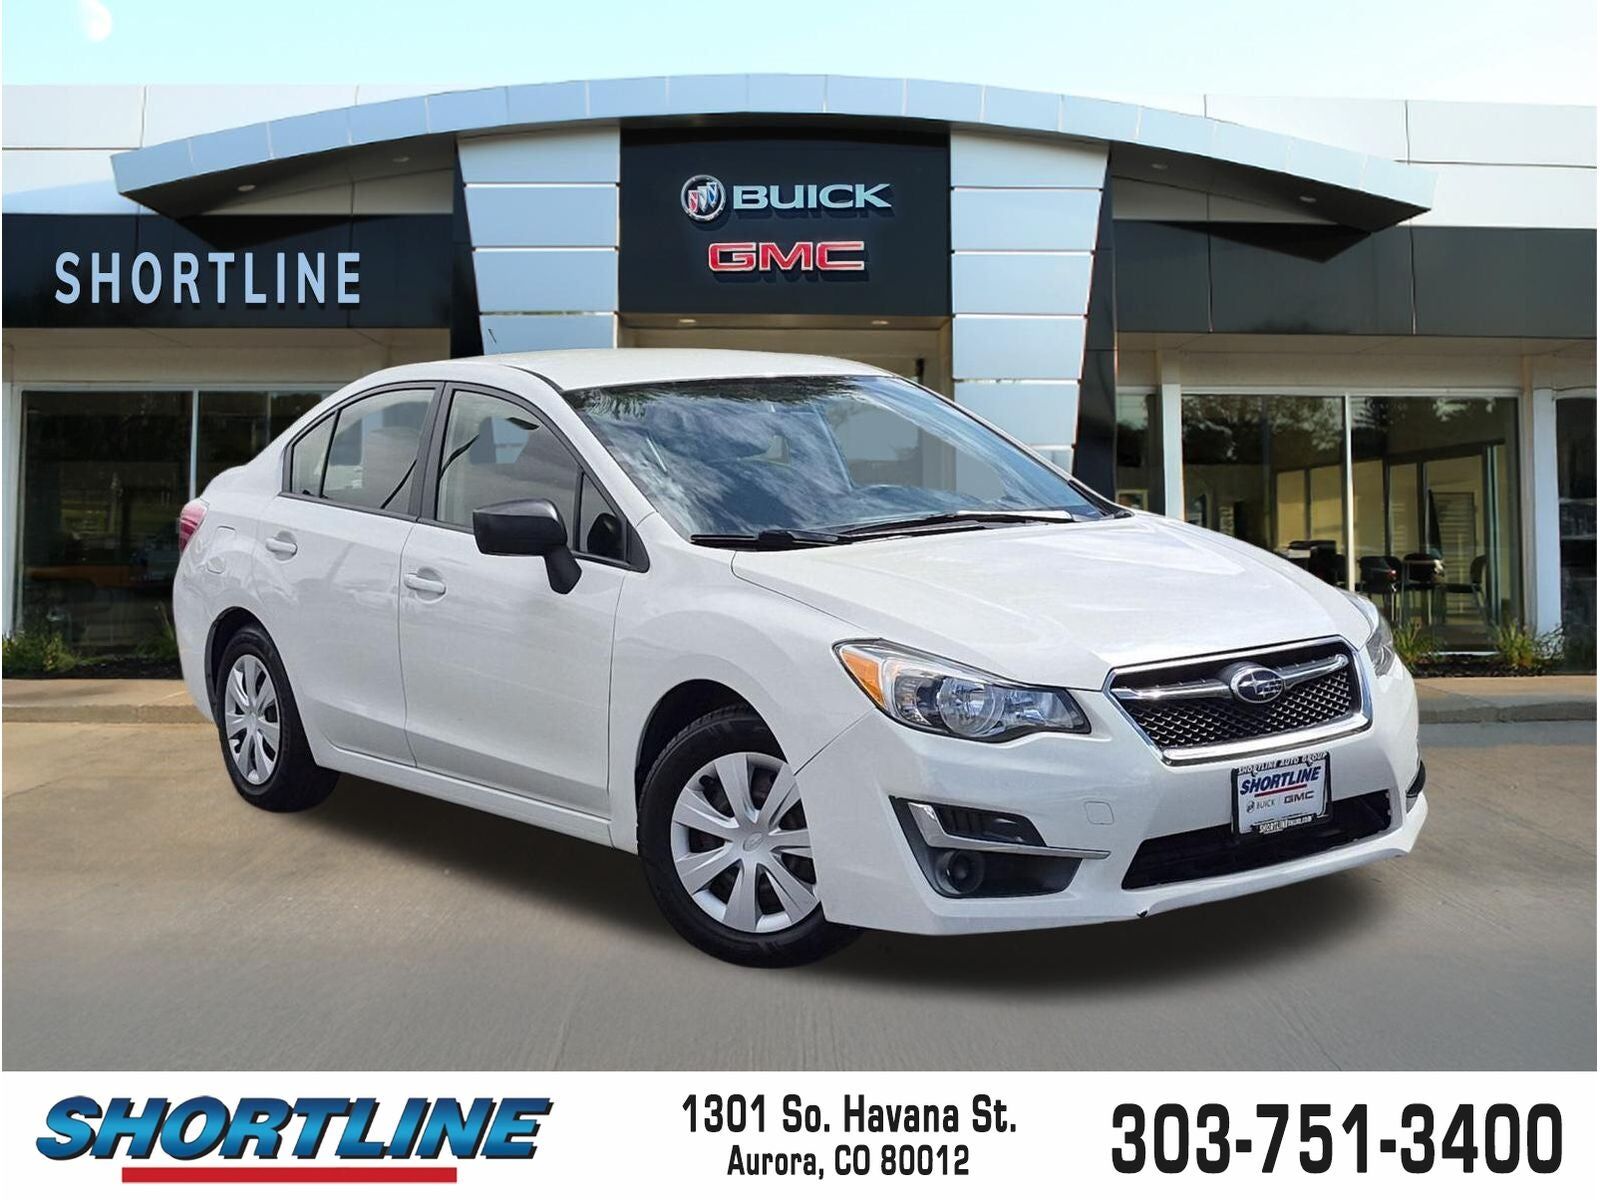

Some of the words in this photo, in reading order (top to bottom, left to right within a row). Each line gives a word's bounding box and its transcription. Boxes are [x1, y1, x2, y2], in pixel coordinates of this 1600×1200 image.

[733, 183, 892, 210] BUICK
[708, 241, 865, 272] GMC
[54, 251, 361, 304] SHORTLINE
[1280, 757, 1300, 767] AUTO
[1240, 766, 1321, 795] SHORTLINE
[1284, 790, 1315, 804] GMC
